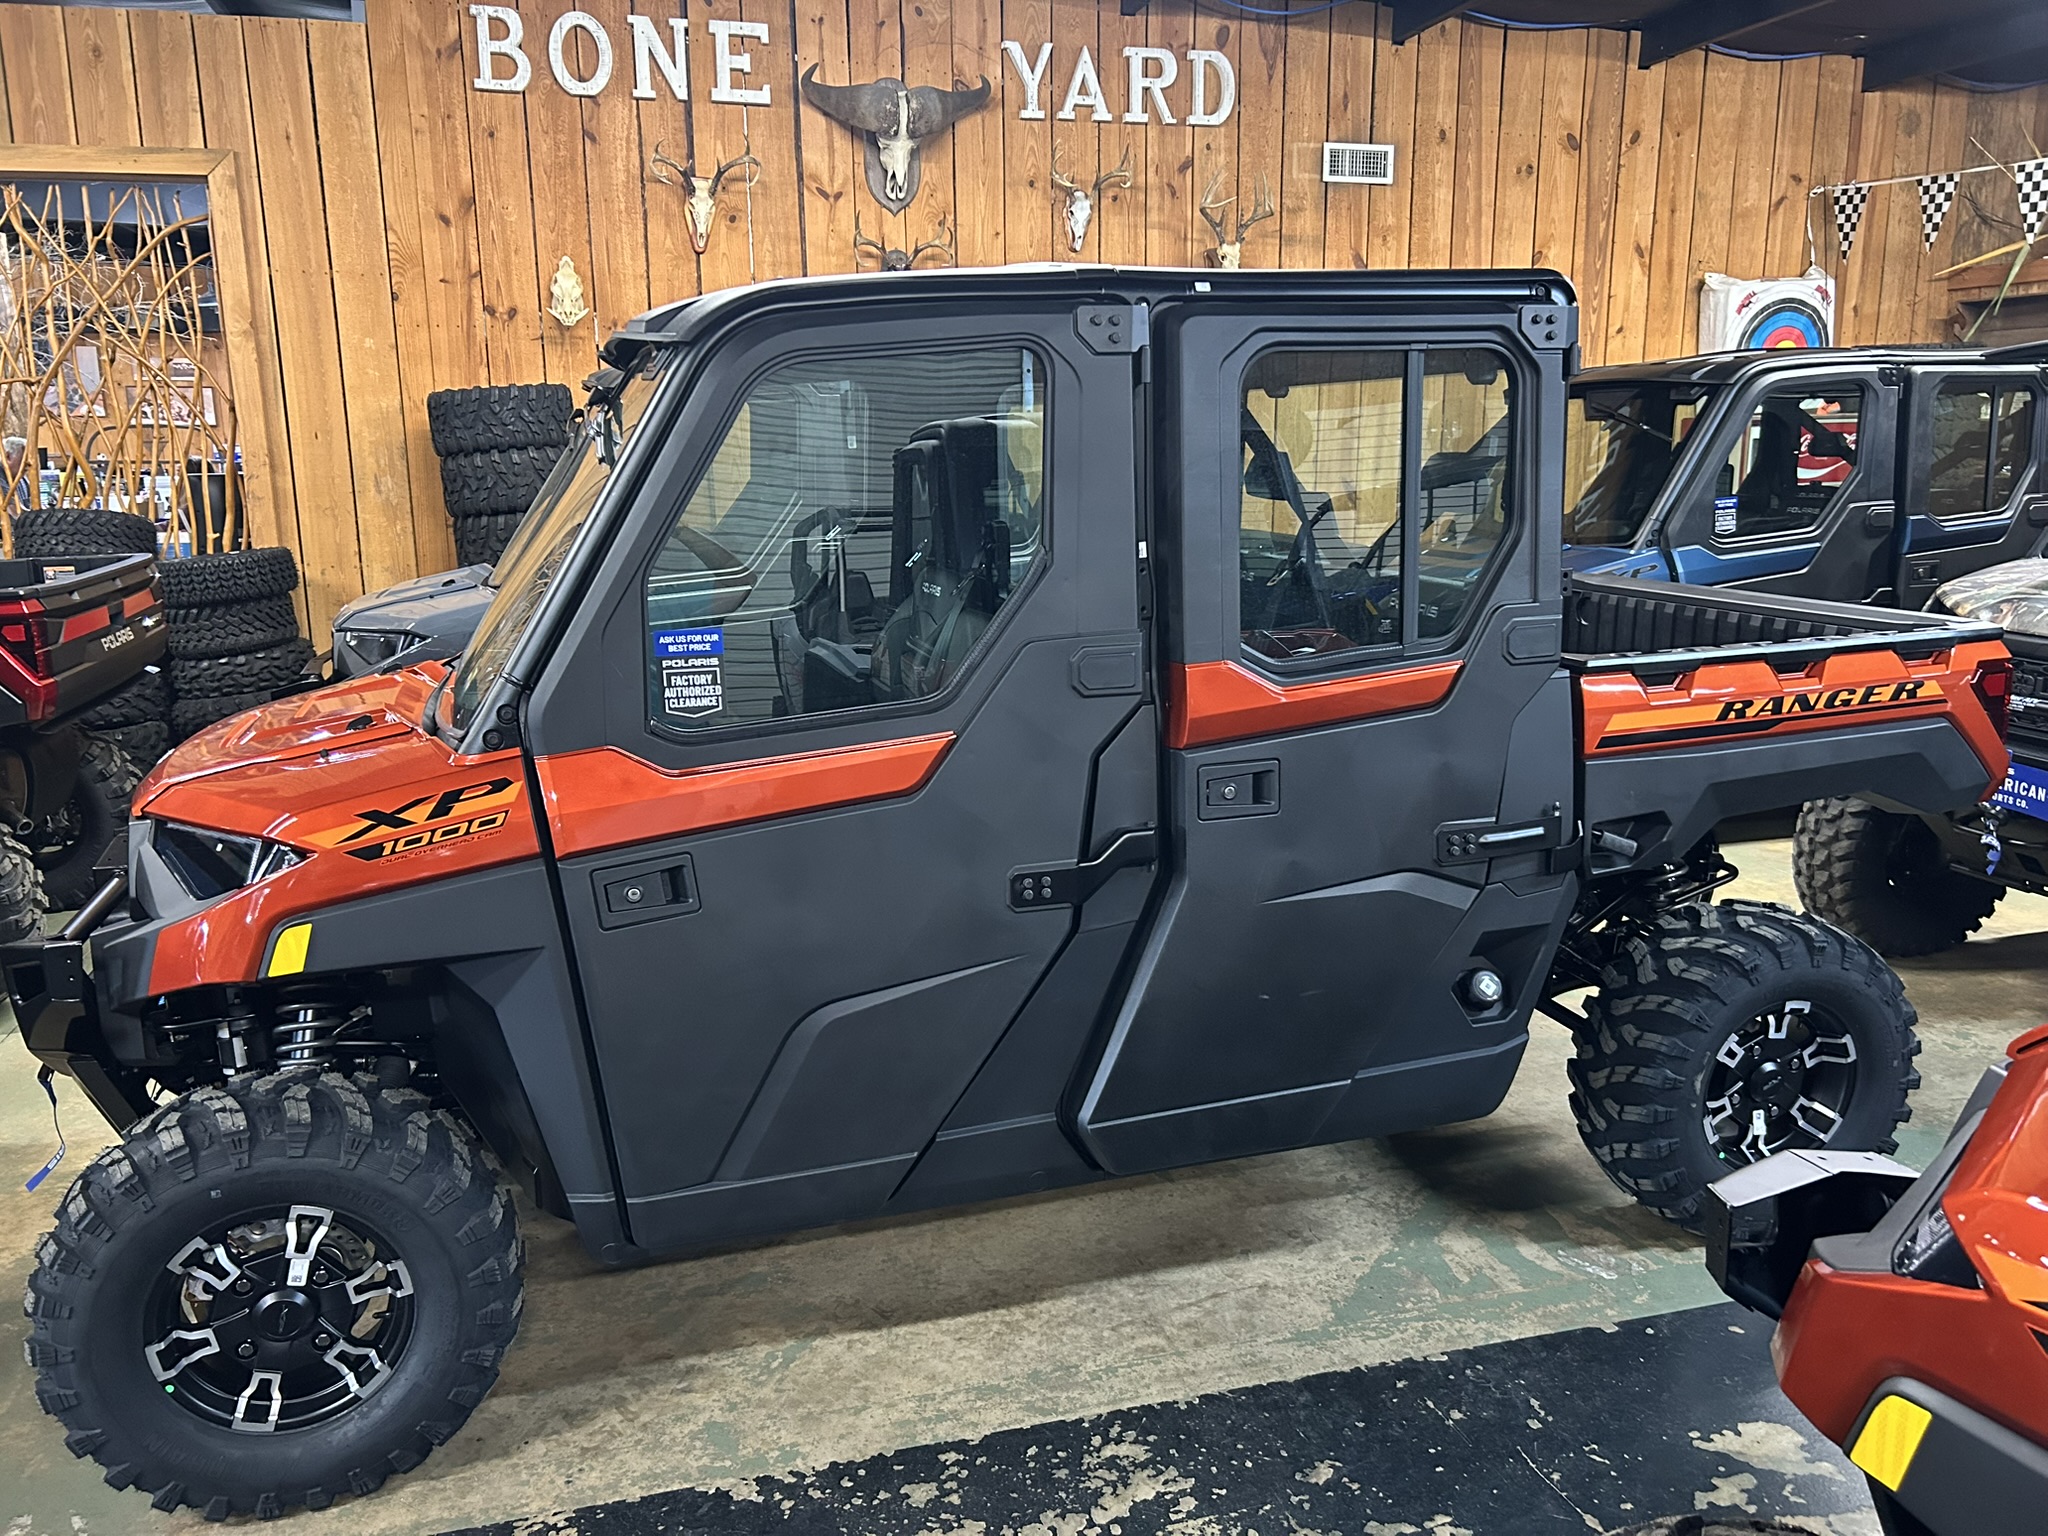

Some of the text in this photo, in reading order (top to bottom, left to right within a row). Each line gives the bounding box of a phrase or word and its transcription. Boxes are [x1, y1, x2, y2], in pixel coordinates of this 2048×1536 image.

[469, 4, 1236, 126] BONE YARD
[100, 626, 135, 651] POLARIS
[658, 633, 720, 644] ASK US FOR OUR
[667, 643, 712, 653] BEST PRICE
[661, 657, 720, 668] POLARIS
[670, 673, 713, 687] FACTORY
[663, 684, 722, 698] AUTHORIZED
[669, 696, 718, 709] CLEARANCE
[1715, 680, 1925, 722] RANGER
[2015, 798, 2029, 810] CO.
[333, 777, 515, 846] XP
[381, 812, 506, 856] 1000
[380, 829, 502, 865] DUAL OVERHEAD CAM
